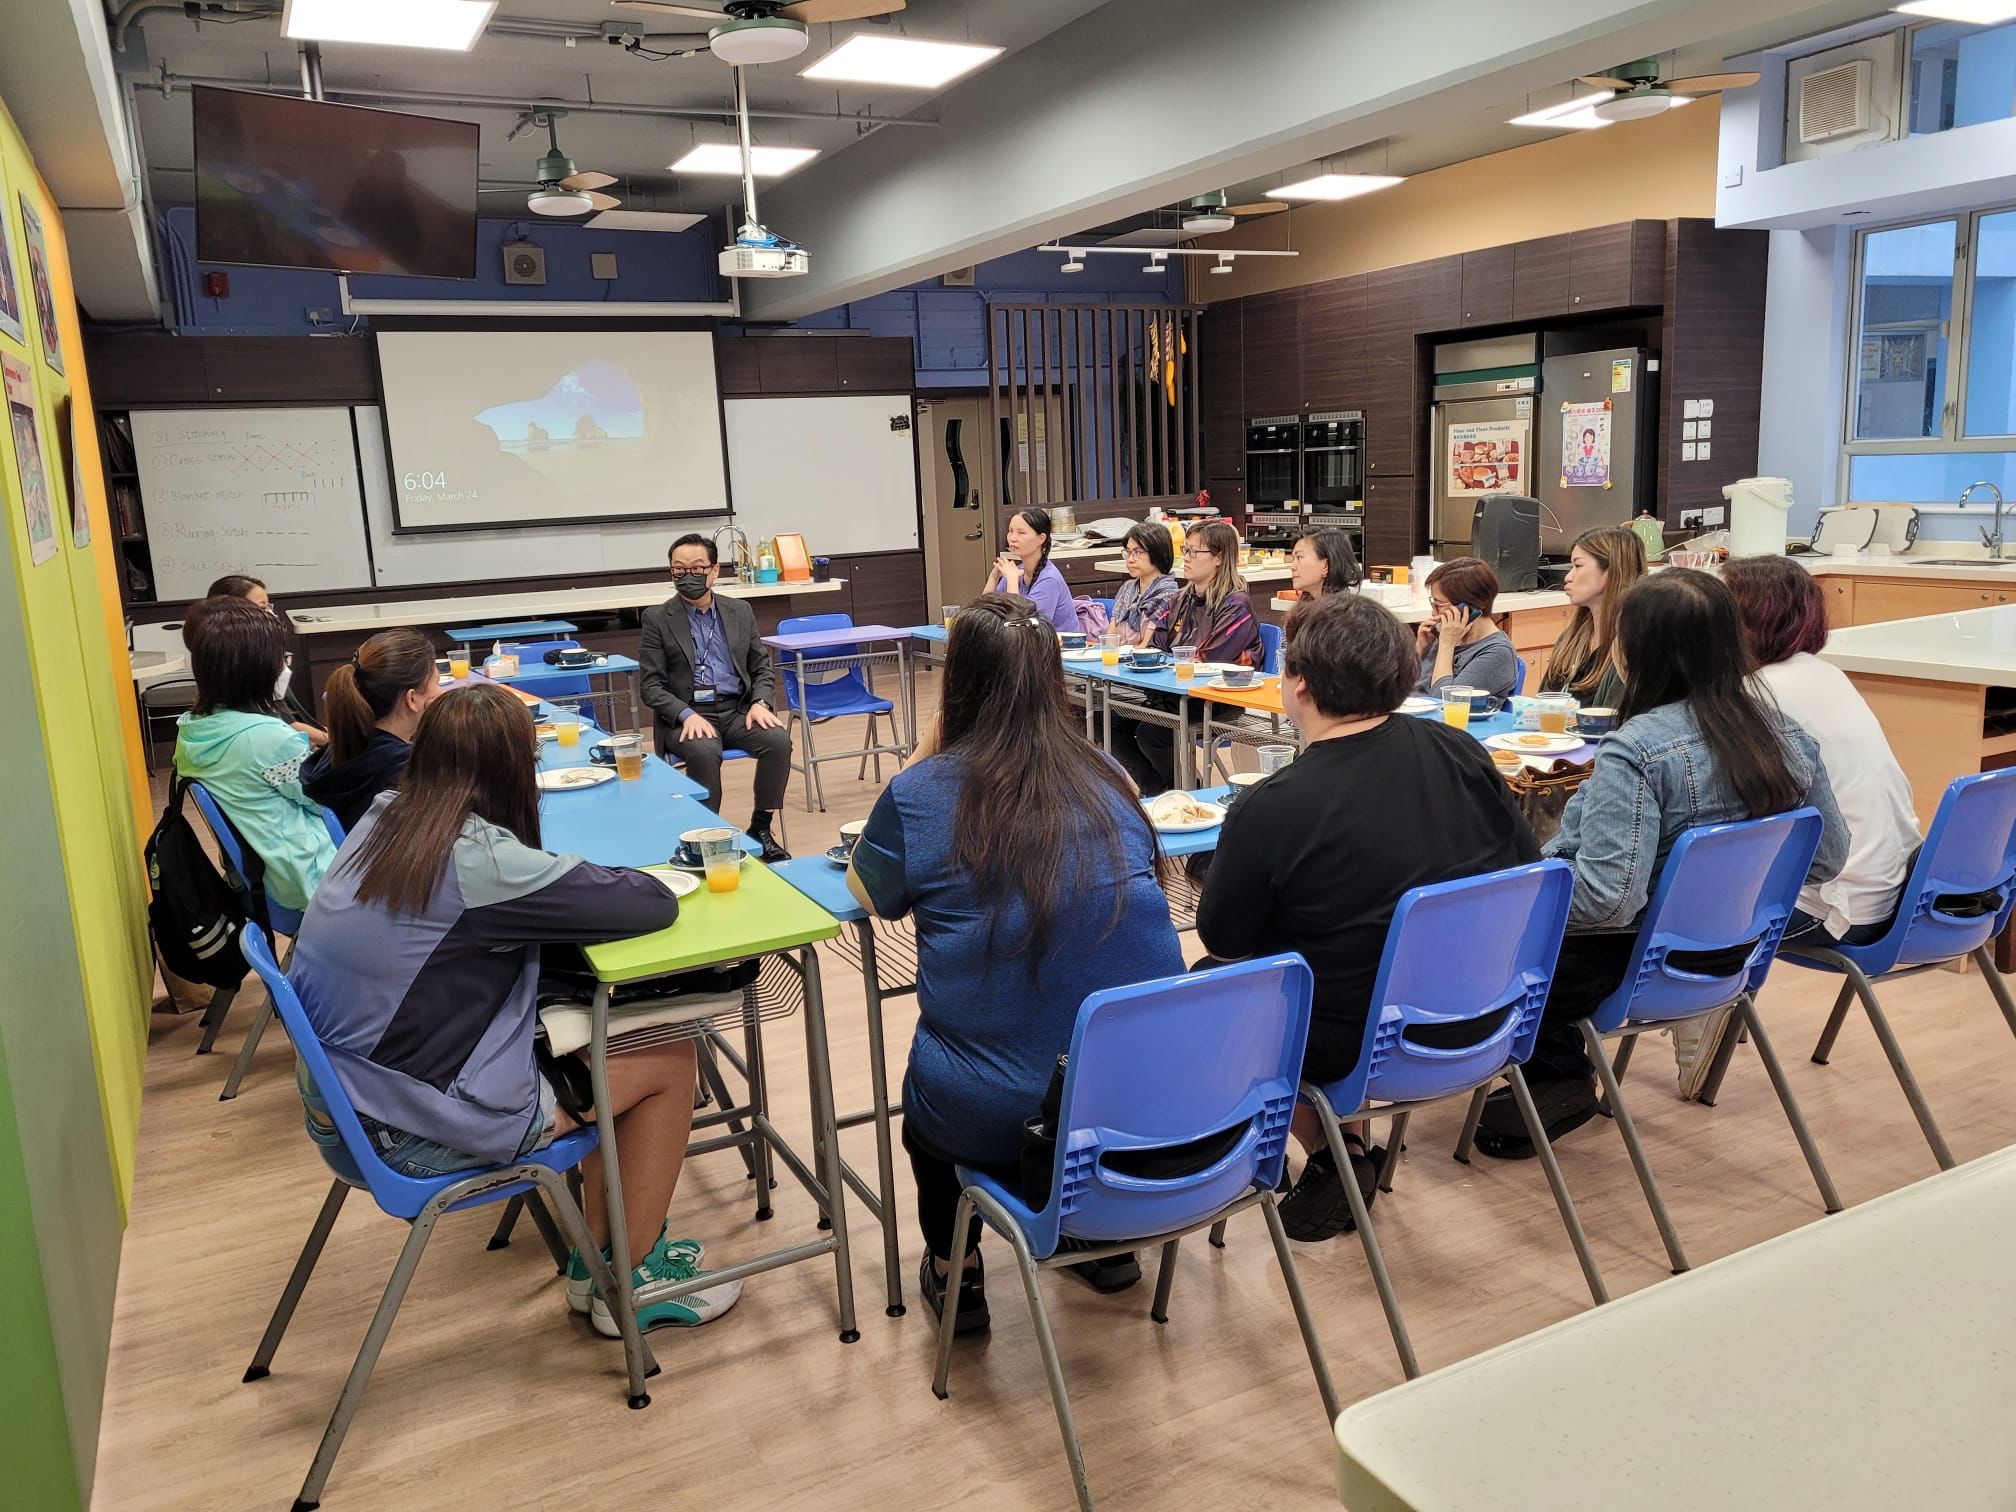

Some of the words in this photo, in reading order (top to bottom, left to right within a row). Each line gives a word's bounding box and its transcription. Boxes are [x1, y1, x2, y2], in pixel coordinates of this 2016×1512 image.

[404, 472, 447, 490] 6:04
[436, 491, 464, 502] March
[465, 489, 479, 500] 24
